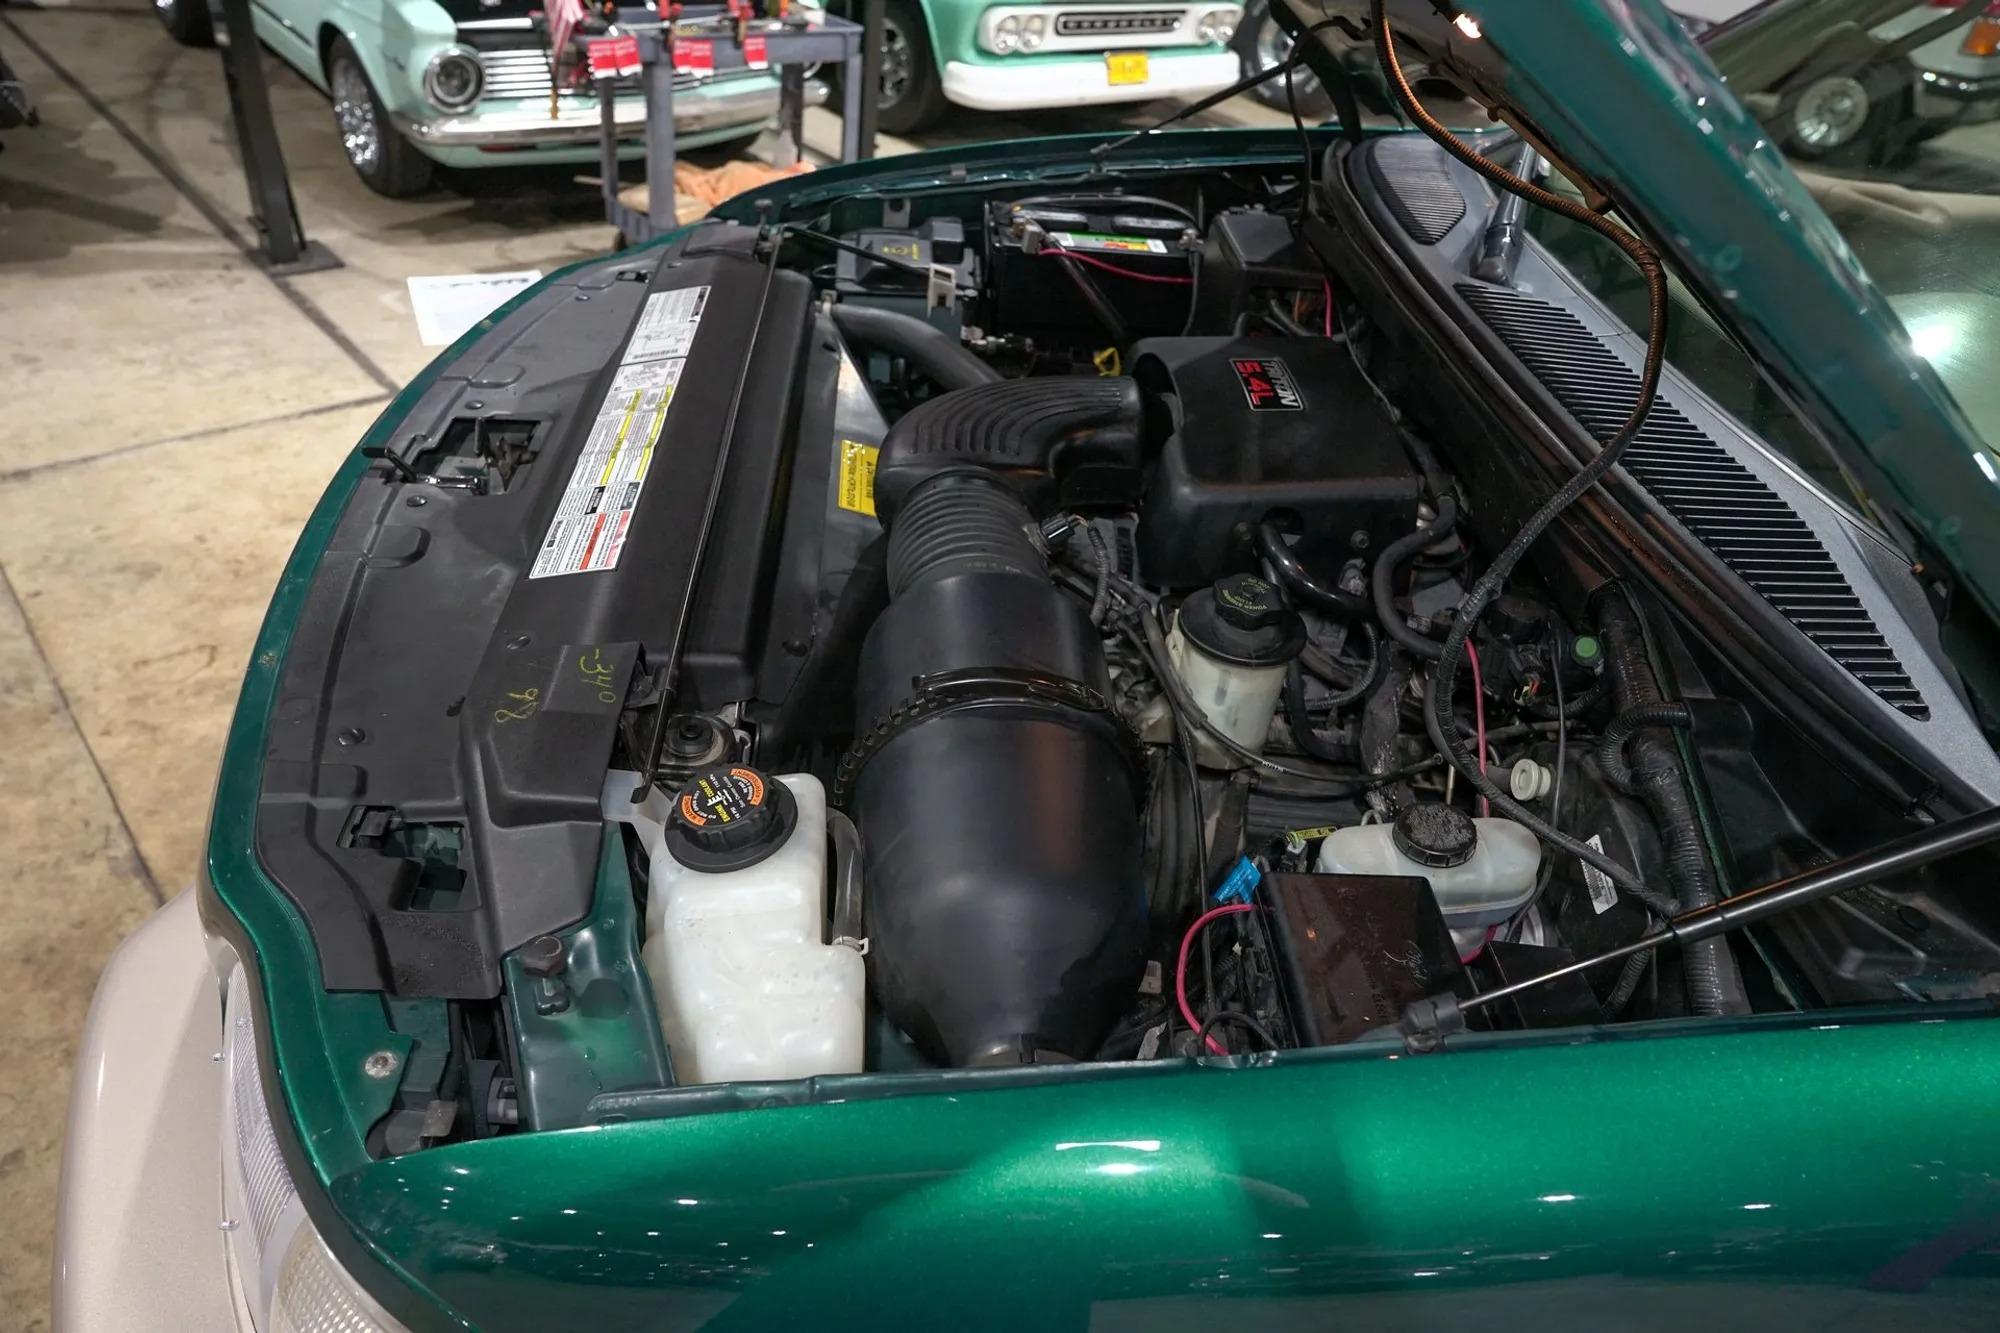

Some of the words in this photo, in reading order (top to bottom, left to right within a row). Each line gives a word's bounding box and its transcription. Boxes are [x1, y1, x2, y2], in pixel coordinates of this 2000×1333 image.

[1235, 361, 1274, 405] 5.4L
[1262, 361, 1300, 407] TRITON
[698, 778, 715, 798] COOLANT
[714, 803, 731, 823] ENGINE
